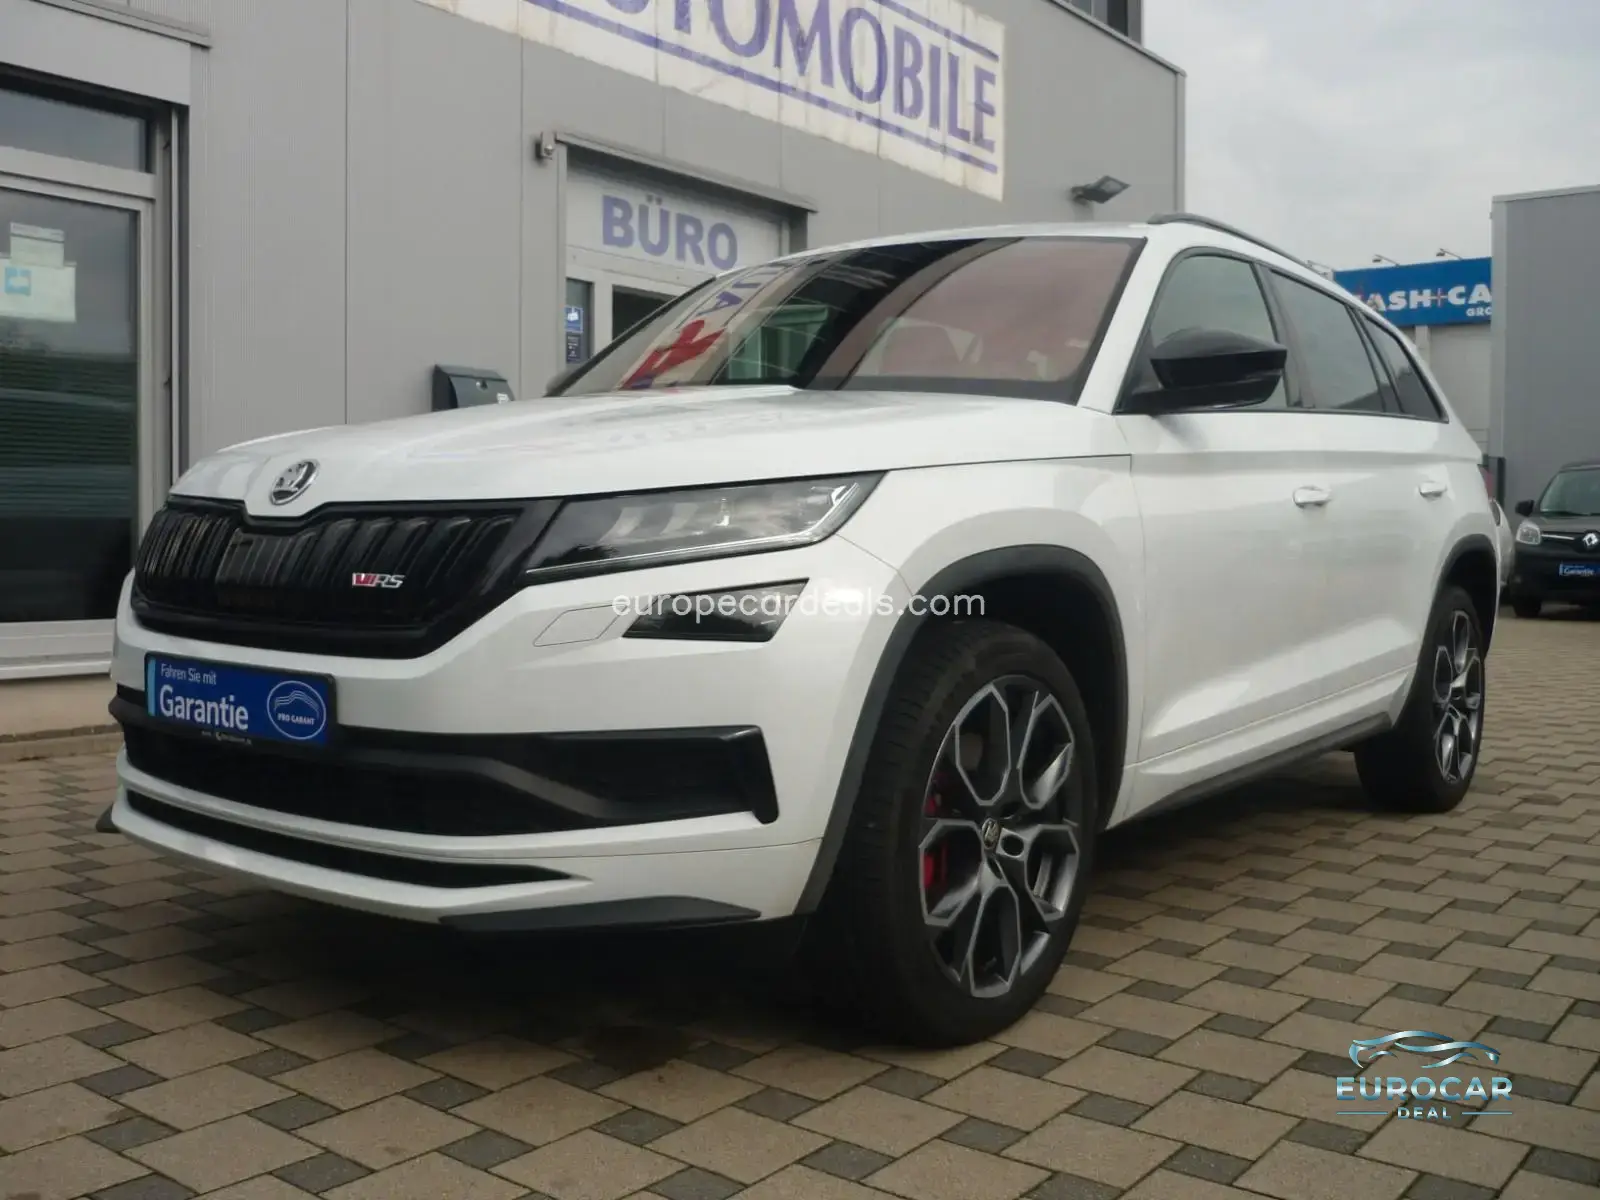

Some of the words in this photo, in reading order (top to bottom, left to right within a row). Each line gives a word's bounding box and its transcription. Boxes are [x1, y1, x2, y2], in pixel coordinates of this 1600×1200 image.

[602, 195, 738, 271] BÜRO
[161, 663, 187, 681] Fahren
[187, 667, 201, 683] Sie
[202, 670, 217, 685] mit
[160, 684, 249, 731] Garantie
[278, 712, 290, 722] PRO
[290, 714, 316, 725] GARANT
